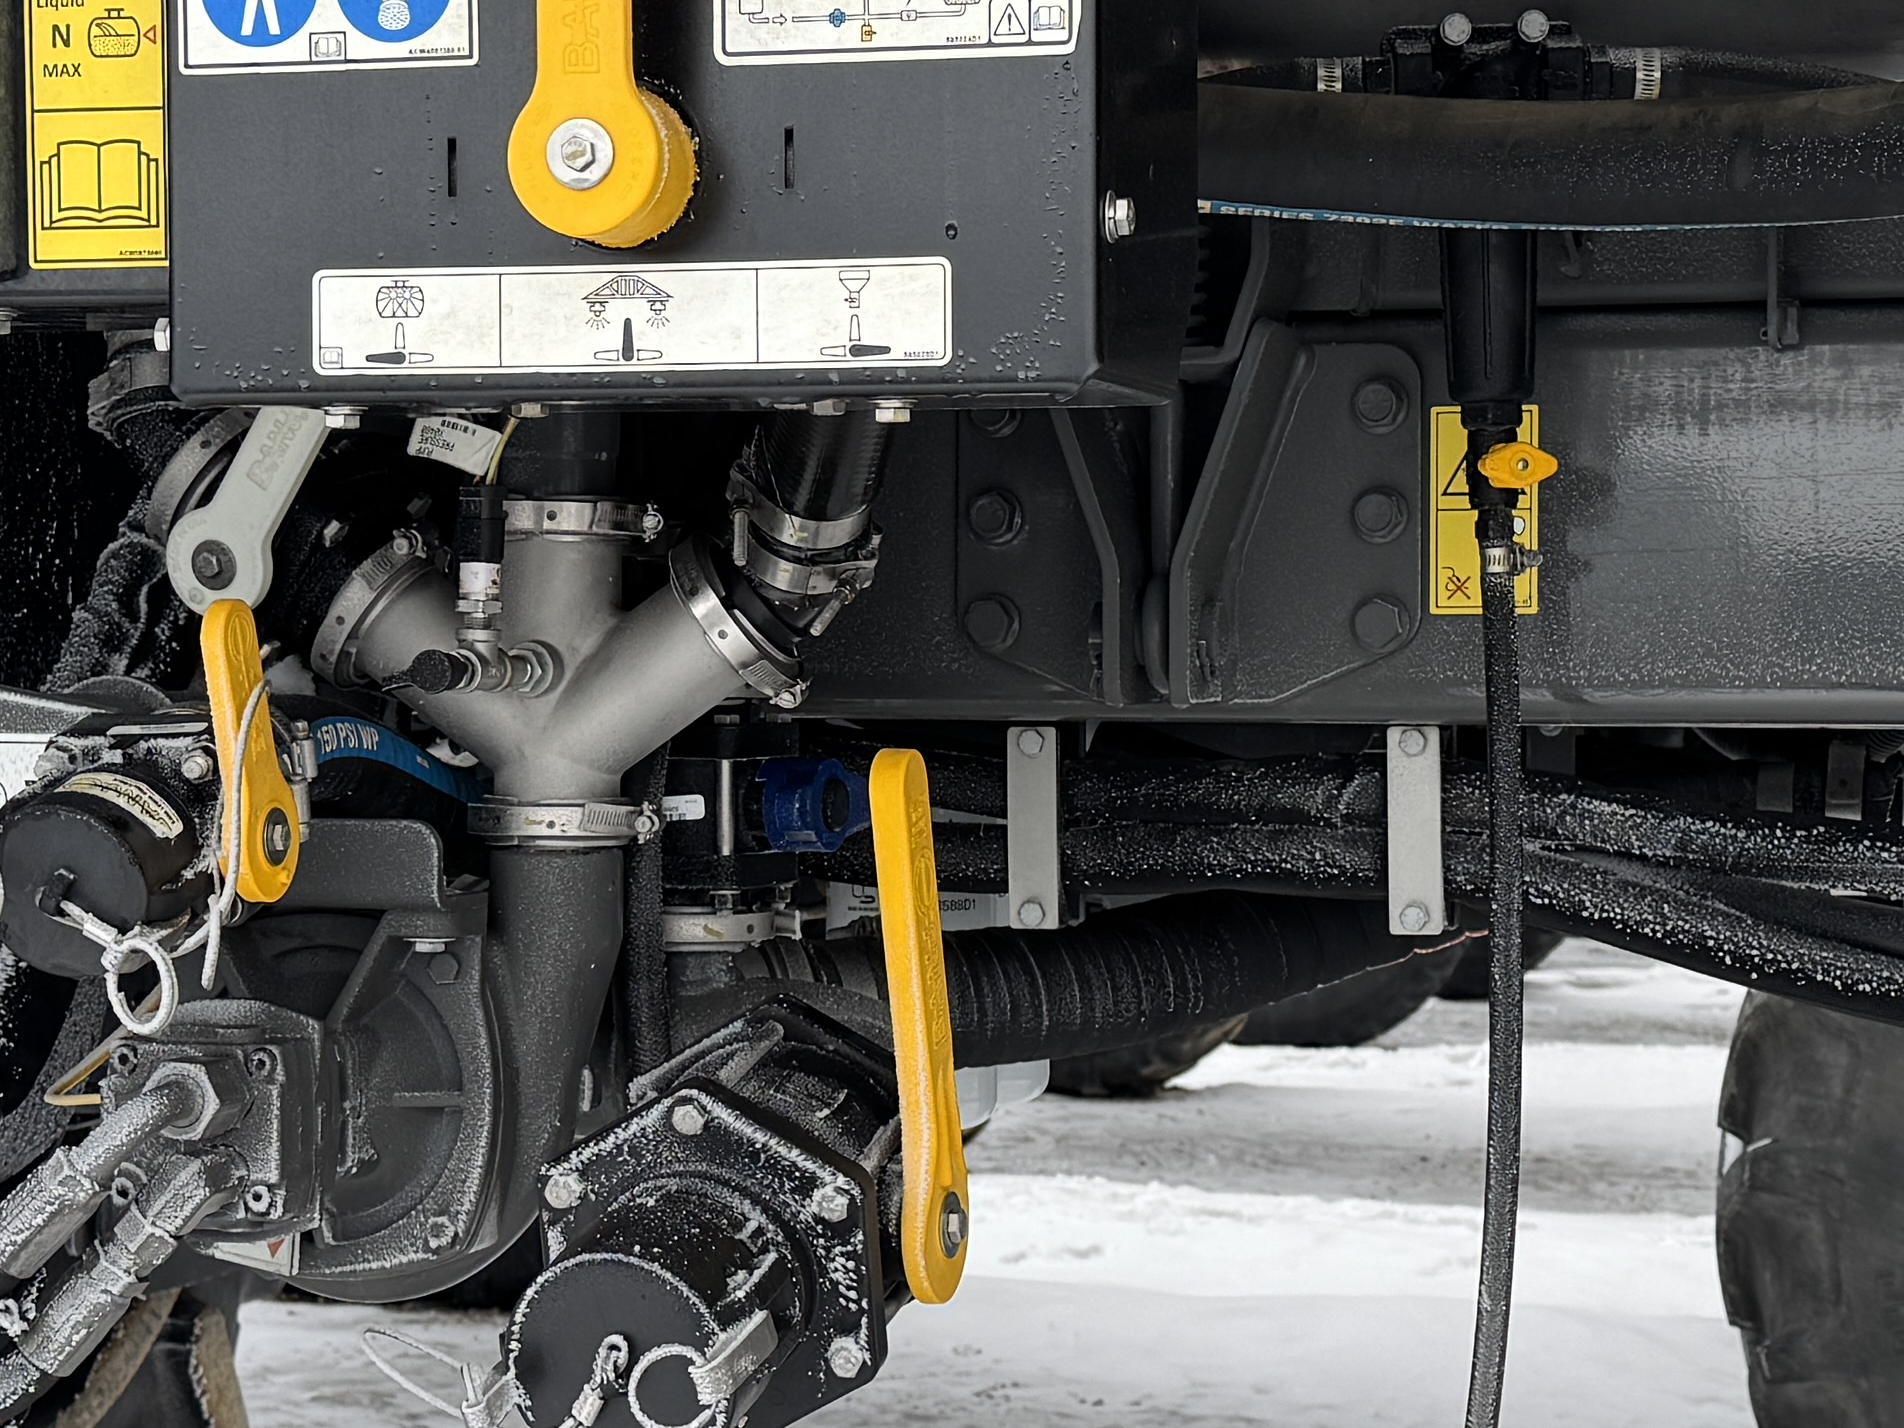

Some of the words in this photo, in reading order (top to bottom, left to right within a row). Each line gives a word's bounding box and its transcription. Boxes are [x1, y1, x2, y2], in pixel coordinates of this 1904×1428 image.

[51, 23, 71, 49] N
[43, 62, 82, 78] MAX
[317, 724, 338, 755] 150
[336, 722, 359, 749] PSI
[357, 723, 380, 751] WP
